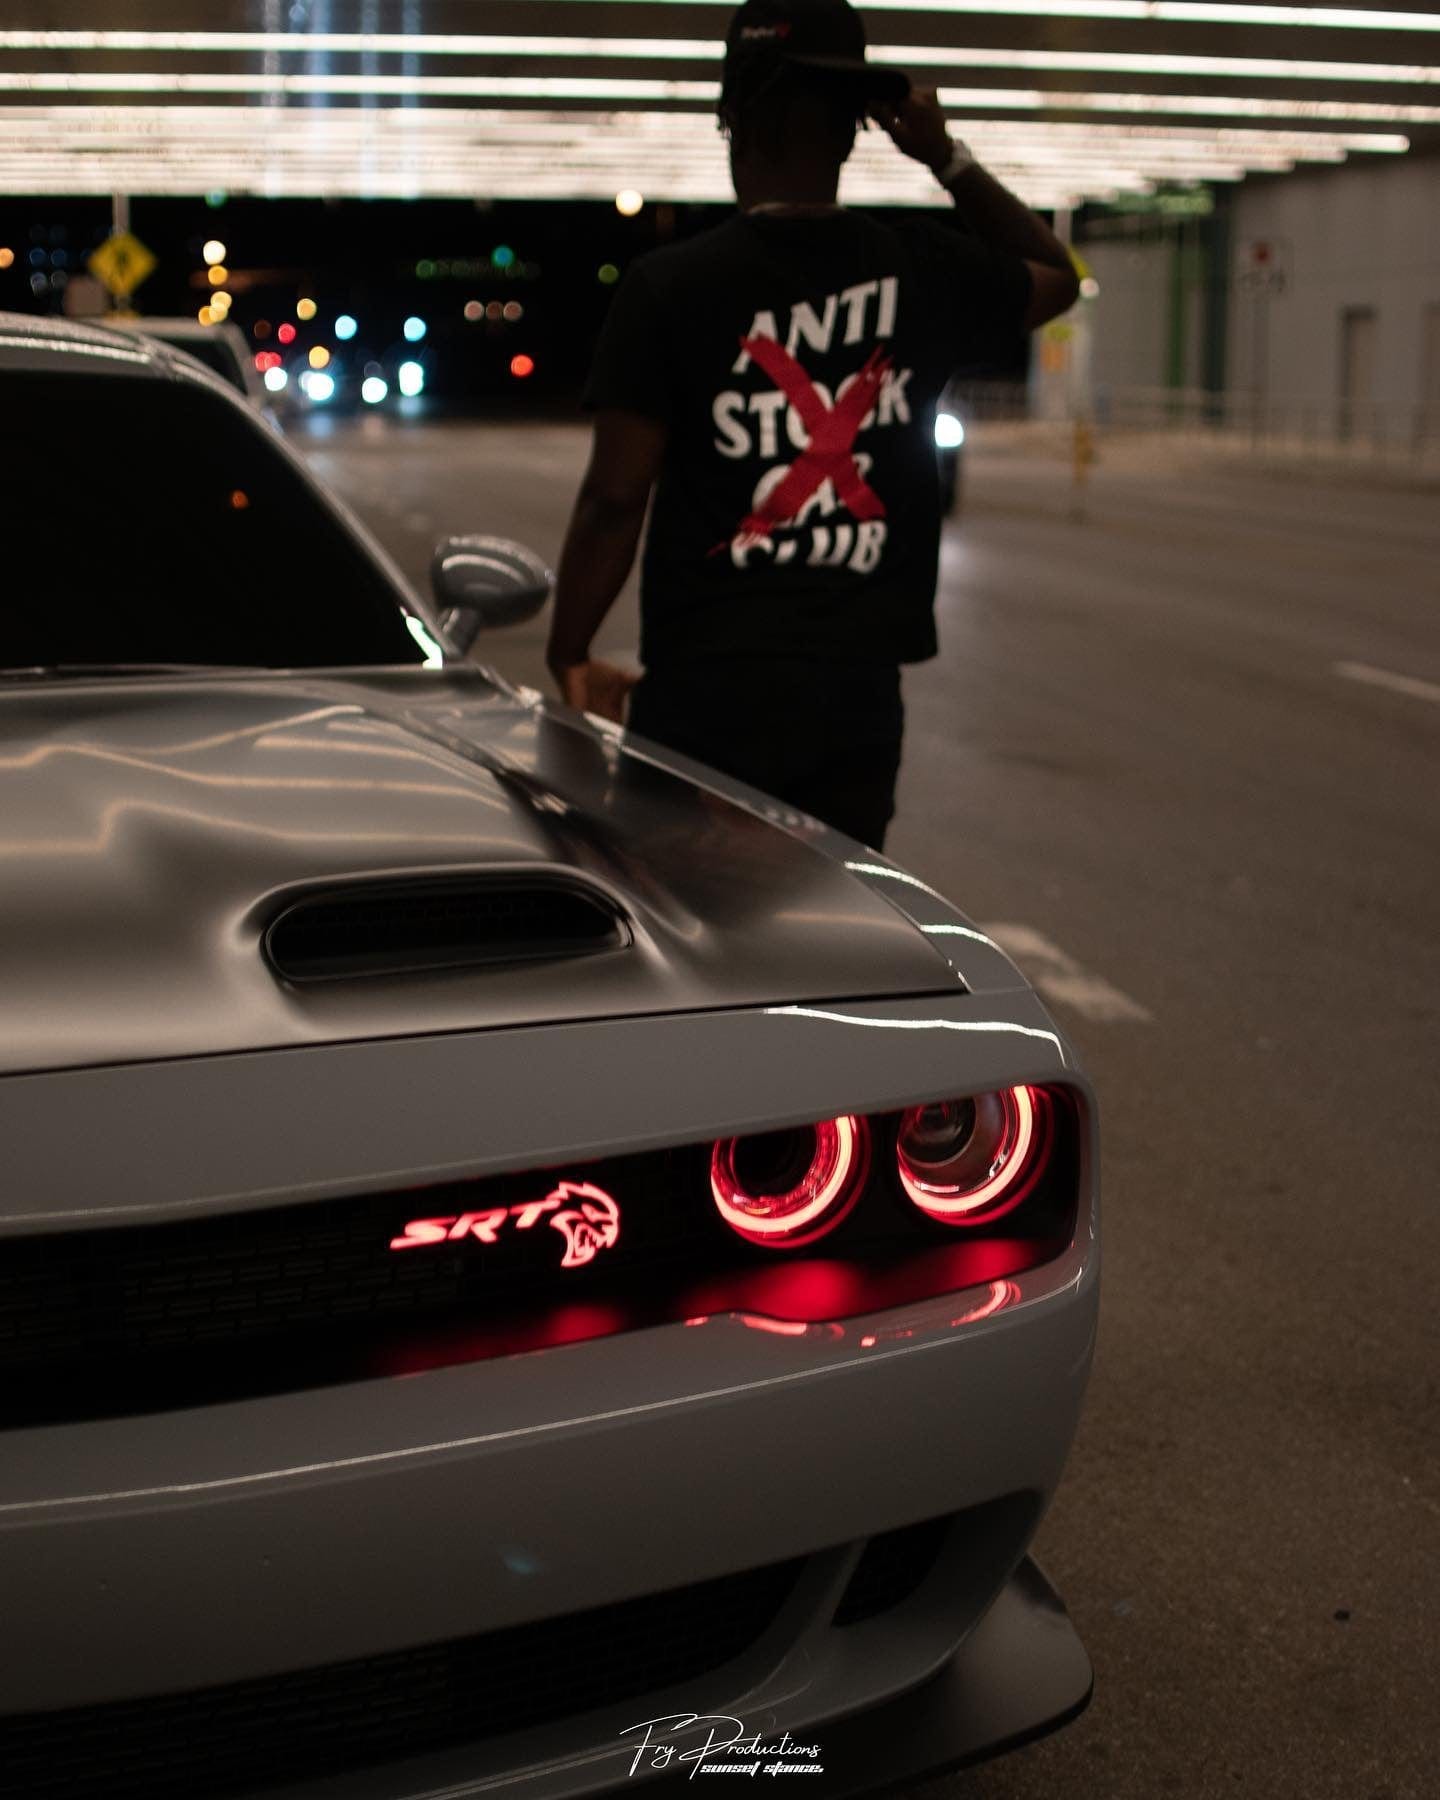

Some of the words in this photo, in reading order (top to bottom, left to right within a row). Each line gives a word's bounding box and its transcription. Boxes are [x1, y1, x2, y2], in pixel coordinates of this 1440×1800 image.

[732, 276, 898, 374] ANTI
[731, 519, 888, 574] CUB
[390, 1199, 561, 1249] SRT
